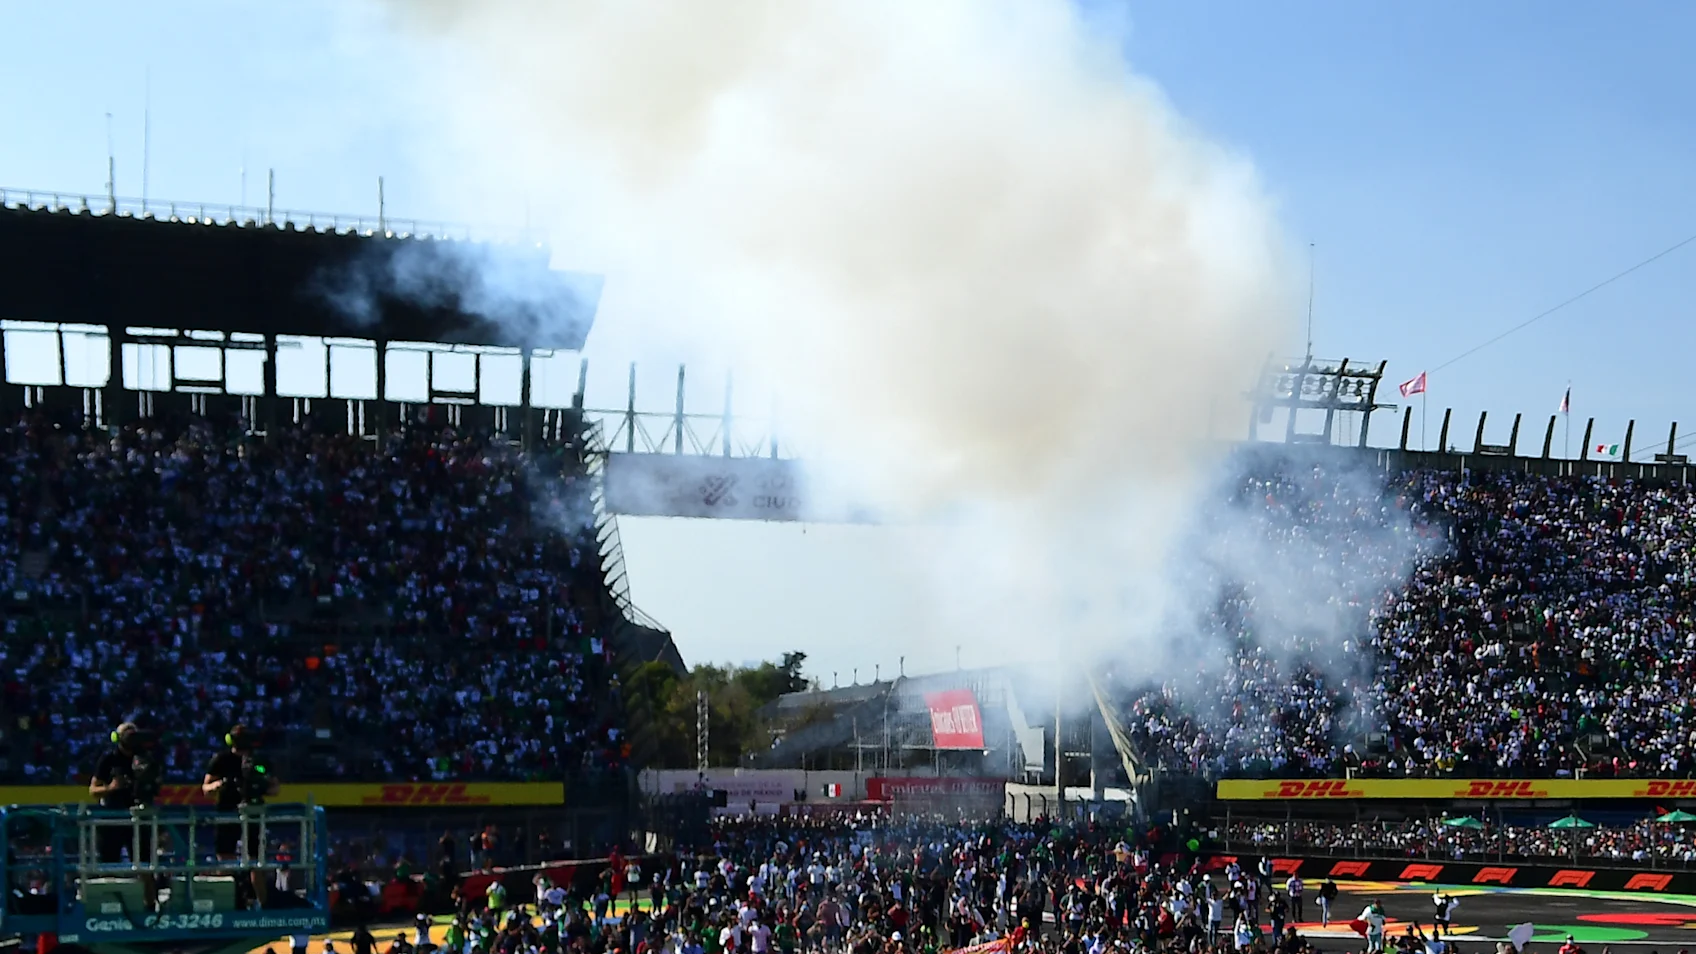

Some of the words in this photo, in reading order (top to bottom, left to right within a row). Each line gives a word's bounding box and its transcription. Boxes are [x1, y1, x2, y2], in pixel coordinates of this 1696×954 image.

[154, 785, 217, 805] HL
[381, 784, 469, 804] DHL
[1278, 781, 1350, 796] DHL
[1468, 781, 1534, 796] DHL
[86, 918, 132, 931] Genie
